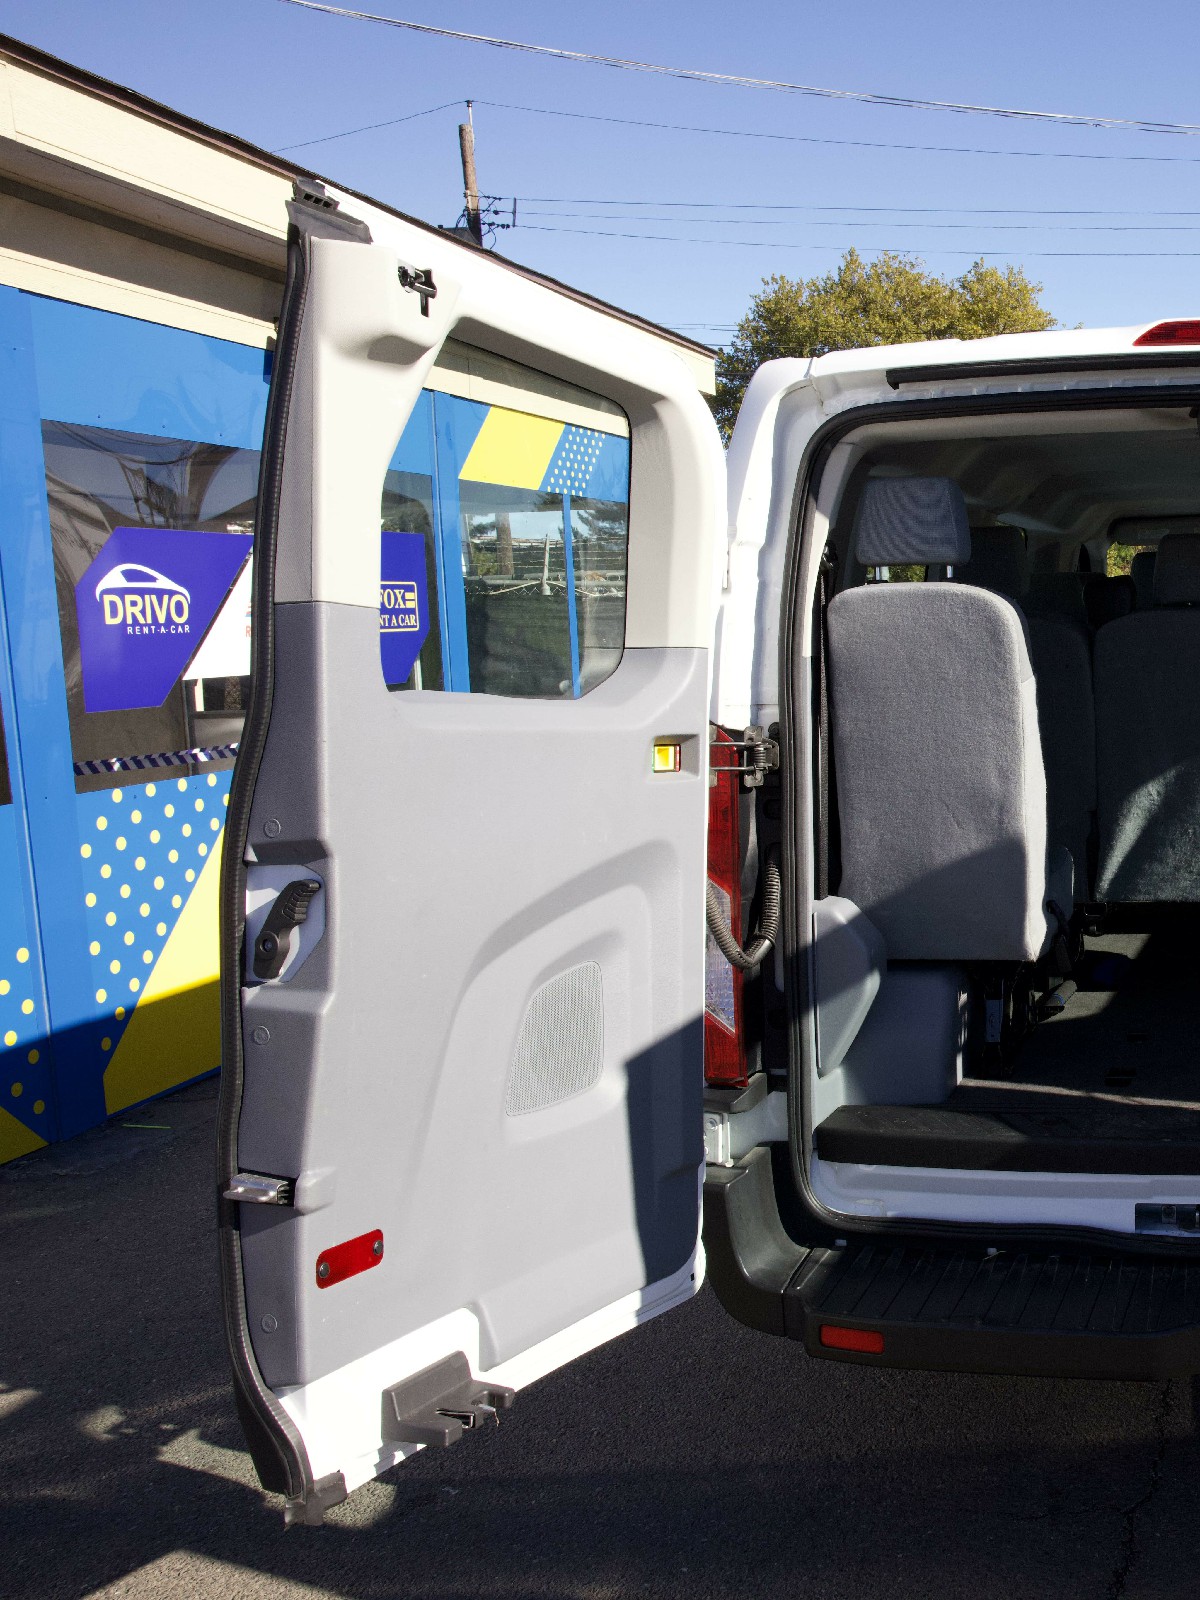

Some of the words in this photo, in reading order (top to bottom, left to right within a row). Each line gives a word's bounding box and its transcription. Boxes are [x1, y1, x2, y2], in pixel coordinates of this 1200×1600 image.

[102, 594, 189, 625] DRIVO
[391, 614, 398, 627] A
[398, 613, 417, 627] CAR
[127, 624, 190, 635] RENT-A-CAR
